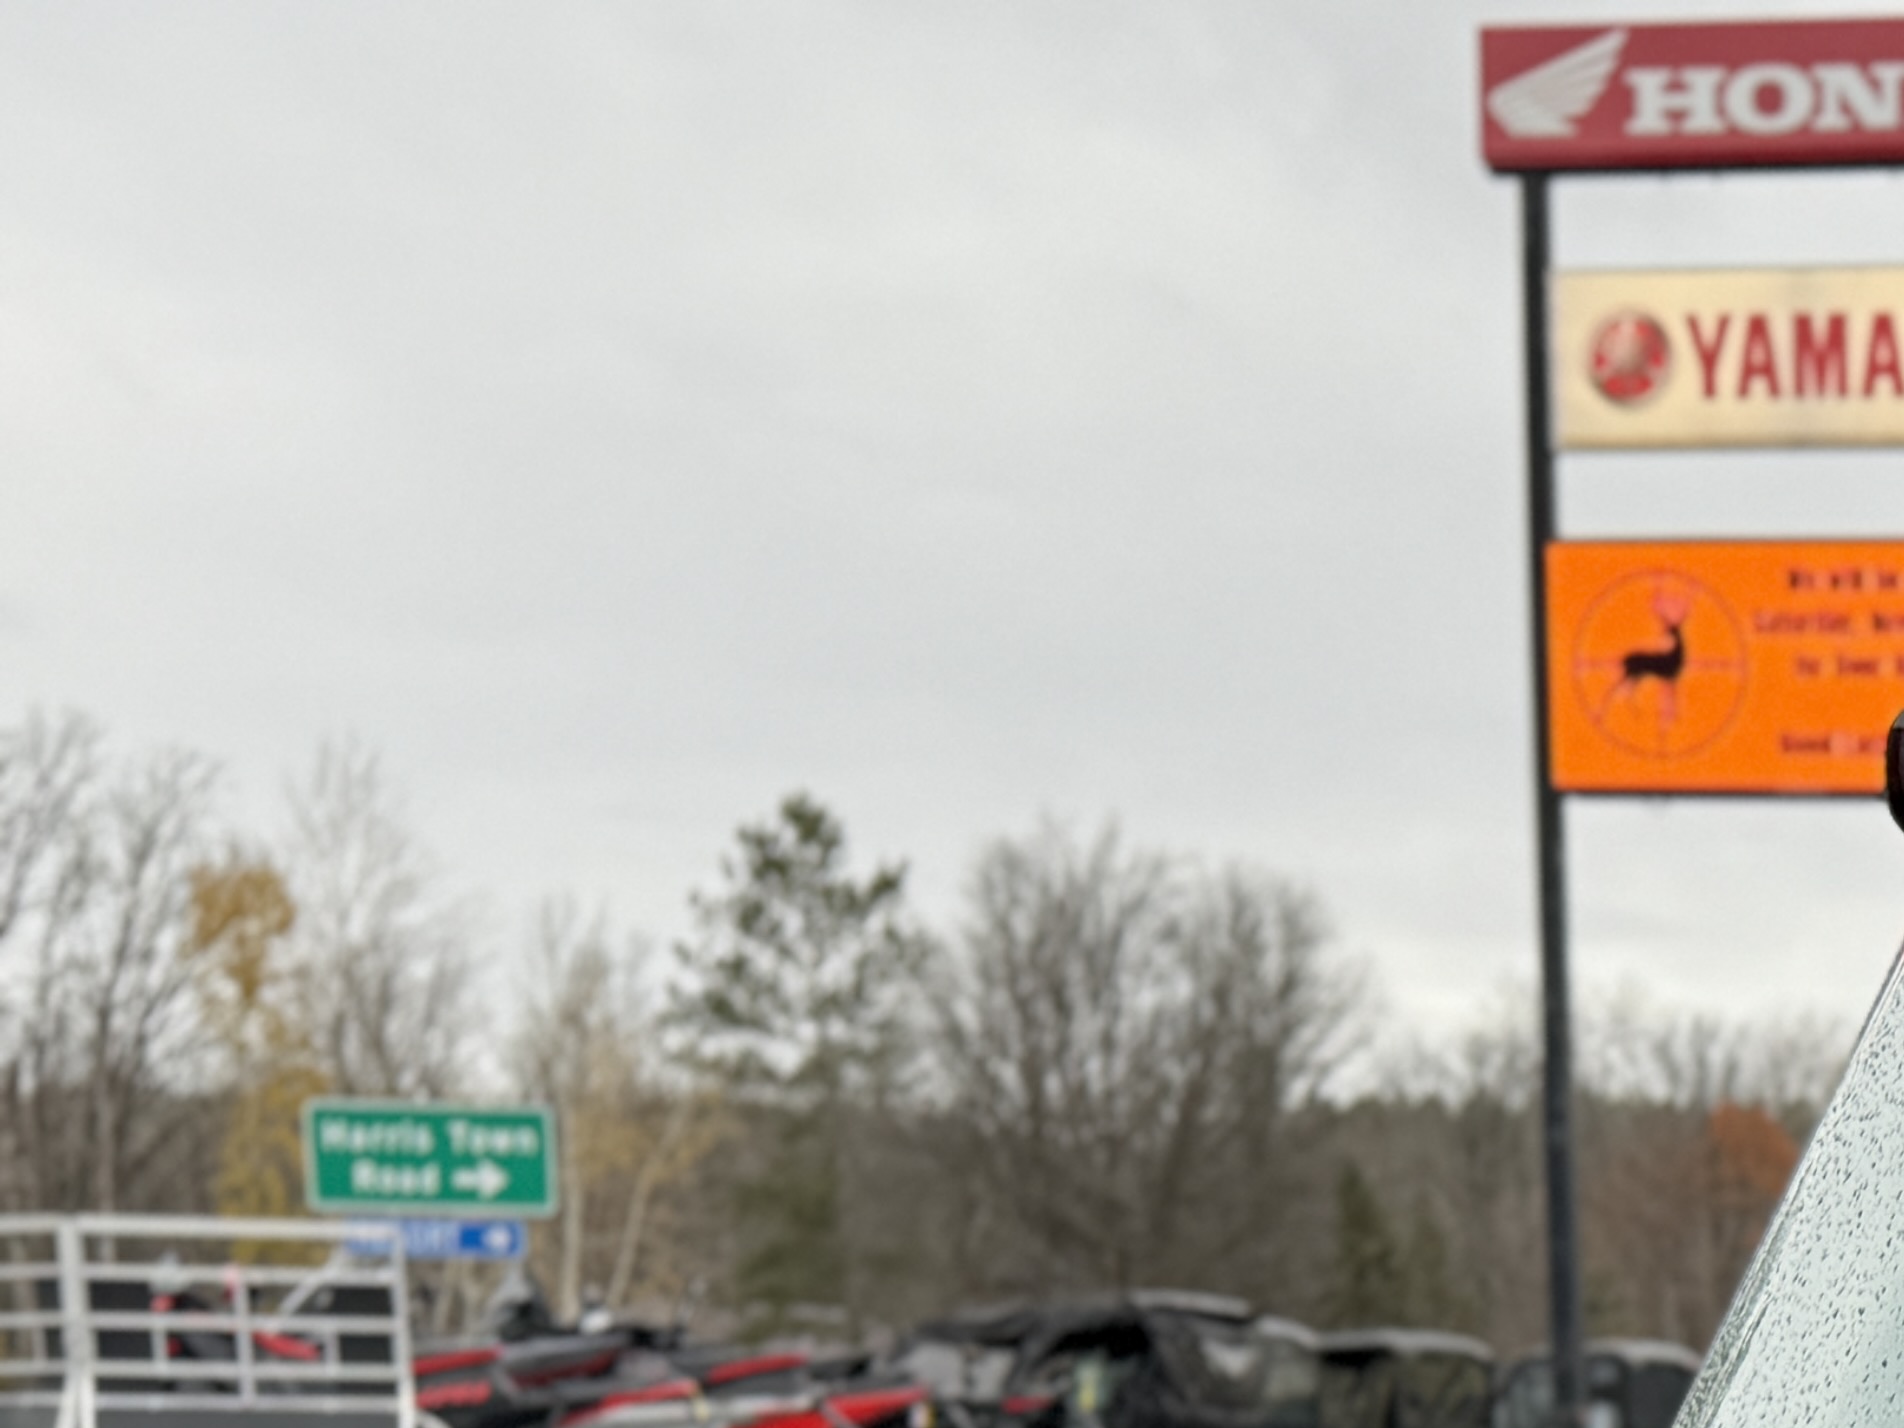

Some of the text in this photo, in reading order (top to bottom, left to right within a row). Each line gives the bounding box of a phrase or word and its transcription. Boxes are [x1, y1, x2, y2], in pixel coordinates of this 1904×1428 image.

[319, 1118, 539, 1156] Harris Town
[350, 1159, 440, 1196] Road
